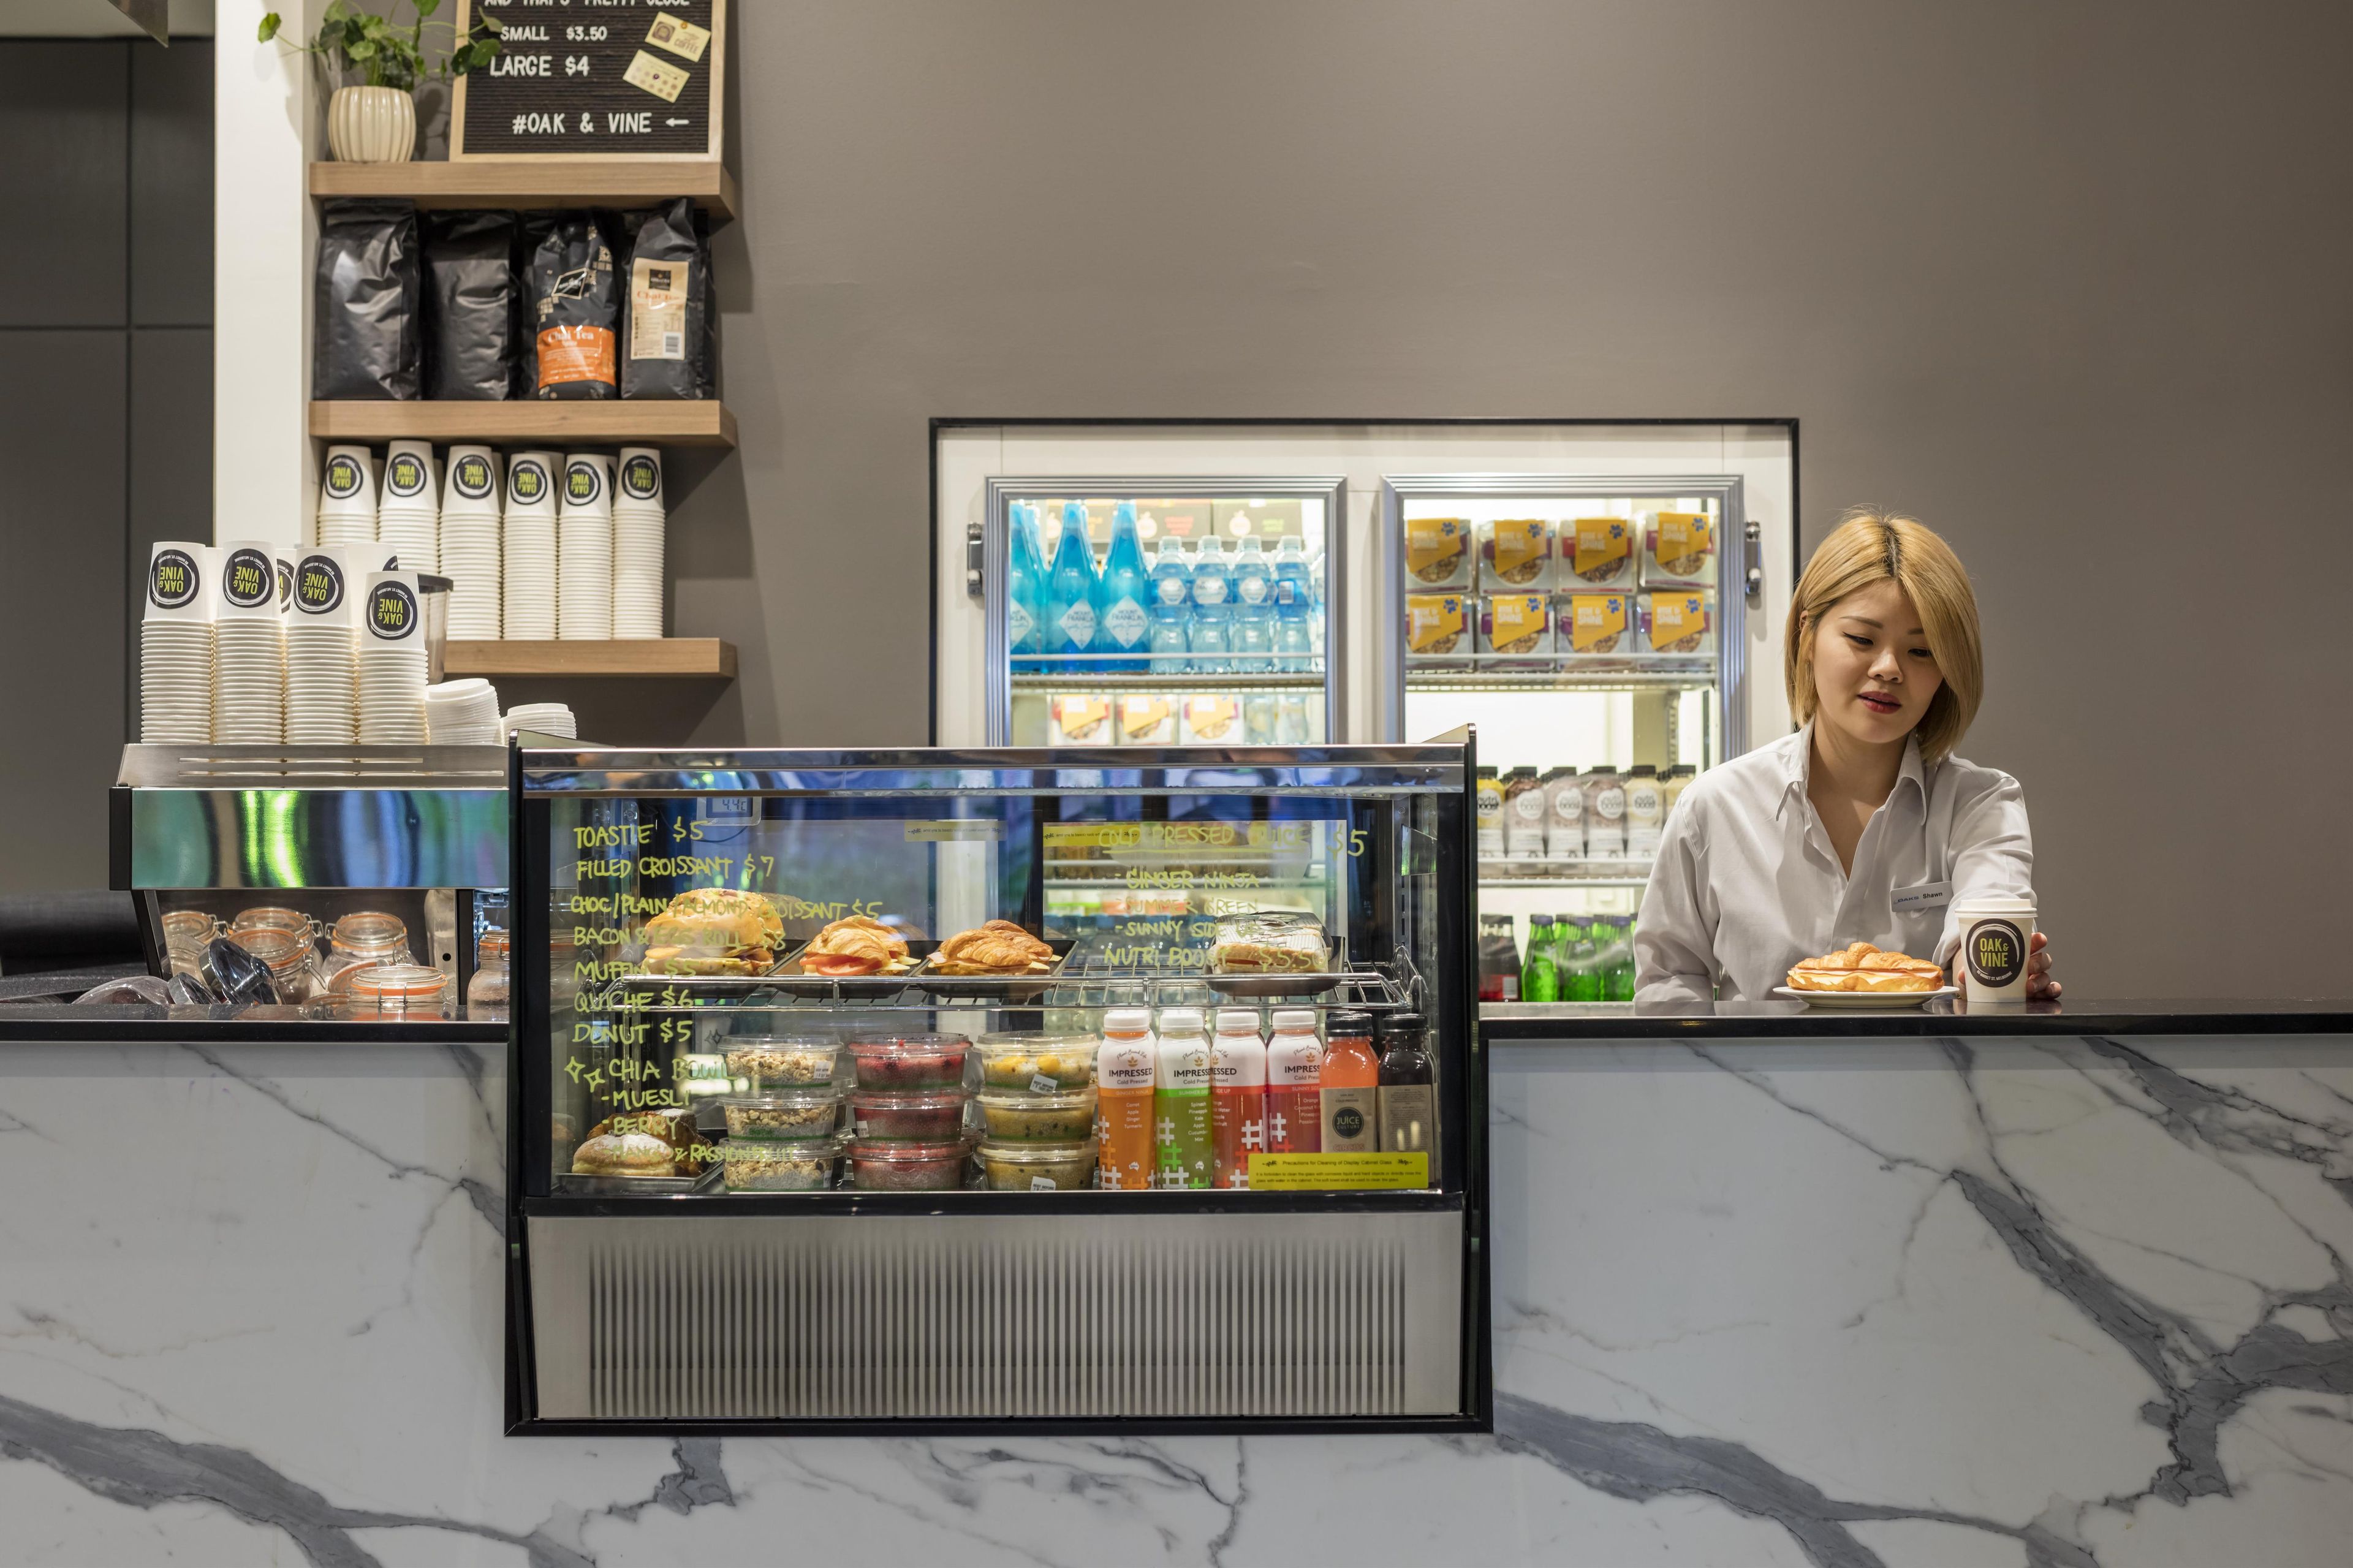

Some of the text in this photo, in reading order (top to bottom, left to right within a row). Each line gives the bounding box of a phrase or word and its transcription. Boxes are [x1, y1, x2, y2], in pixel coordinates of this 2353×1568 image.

[500, 26, 608, 41] SMALL $3.50
[490, 55, 590, 77] LARGE $4
[512, 112, 652, 134] #OAK & VINE
[574, 329, 594, 341] Tea
[333, 467, 351, 477] VINE
[397, 465, 415, 476] VINE
[464, 464, 484, 476] VINE
[518, 473, 537, 483] VINE
[634, 467, 652, 479] VINE
[571, 474, 589, 485] VINE
[160, 567, 184, 580] VINE
[235, 566, 259, 583] VINE
[305, 573, 328, 589] VINE
[379, 599, 403, 613] VINE
[574, 816, 708, 849] TOASTIE $5
[1099, 825, 1141, 848] COLD
[1152, 825, 1235, 848] PRESSED
[1327, 824, 1368, 861] $5
[577, 861, 631, 881] FILLED
[639, 855, 733, 879] CROISSANT
[1203, 871, 1260, 890] NINJA
[758, 901, 848, 921] CROISSANT
[852, 898, 883, 920] $5
[1203, 897, 1258, 915] GREEN
[1191, 921, 1228, 938] SIDE
[573, 926, 631, 946] BACON
[635, 927, 647, 945] &
[702, 927, 749, 950] ROLL
[760, 928, 786, 950] $8
[1104, 947, 1160, 966] NUTRI
[1169, 948, 1232, 968] BOOST
[1980, 952, 2008, 967] VINE
[574, 958, 700, 982] MUFFIN $5
[573, 985, 694, 1014] QUICHE $6
[572, 1018, 694, 1044] DONUT $5
[609, 1058, 738, 1081] CHIA BOWL
[1108, 1068, 1153, 1078] IMPRESSED
[1284, 1065, 1320, 1074] IMPRESS
[1336, 1115, 1360, 1125] JUICE
[1333, 1143, 1365, 1152] CIRCUS
